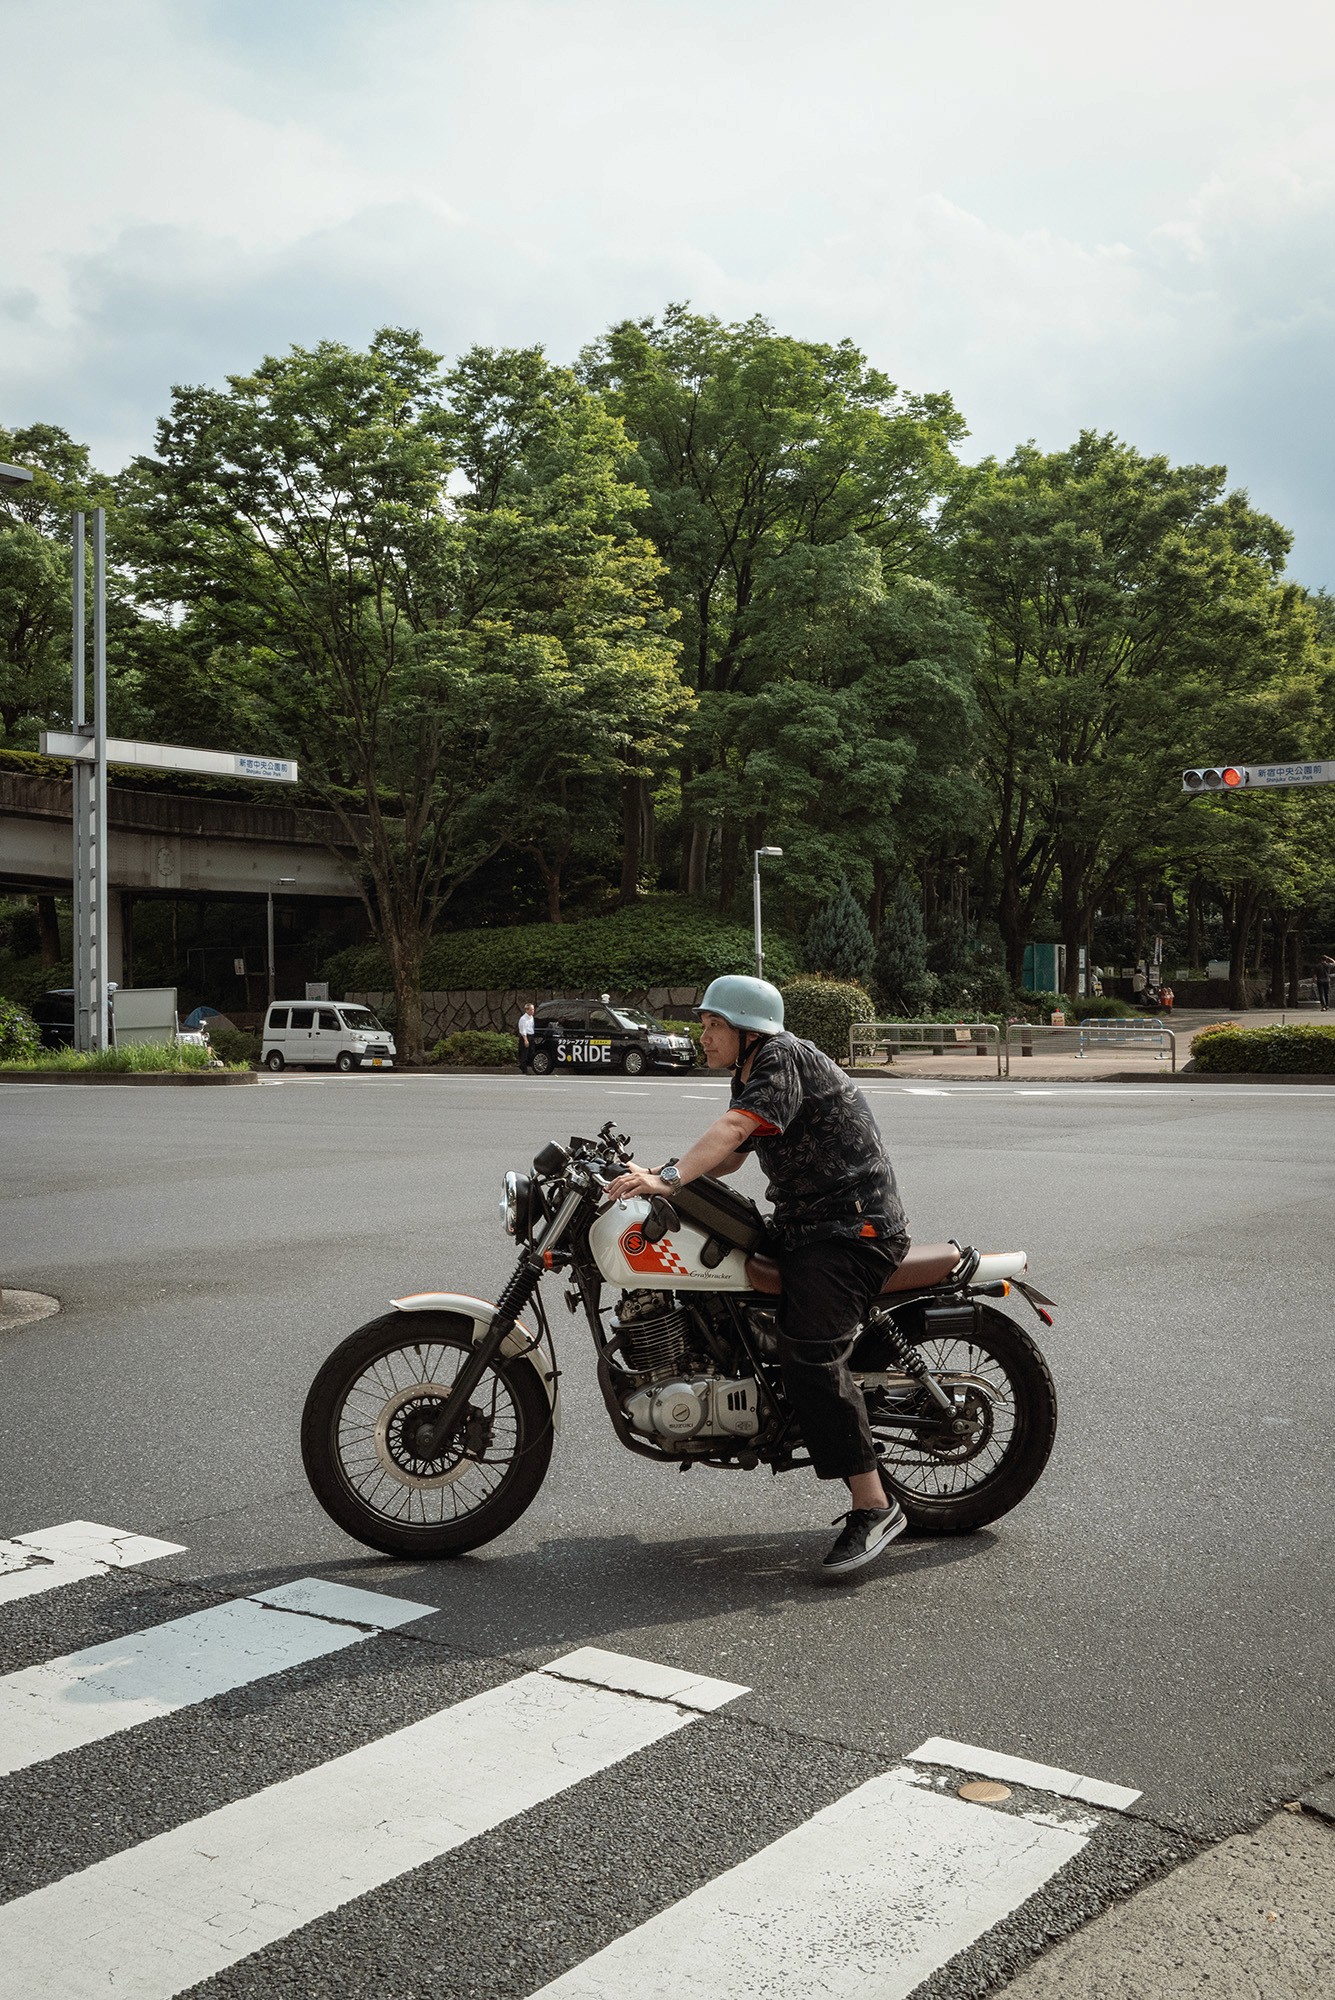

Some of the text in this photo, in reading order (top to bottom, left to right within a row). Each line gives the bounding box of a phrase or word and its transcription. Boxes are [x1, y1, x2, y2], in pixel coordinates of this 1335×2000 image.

[239, 758, 288, 773] 新宿中央公園前
[1258, 765, 1322, 777] 新宿中央公園前
[557, 1045, 611, 1062] S.RIDE
